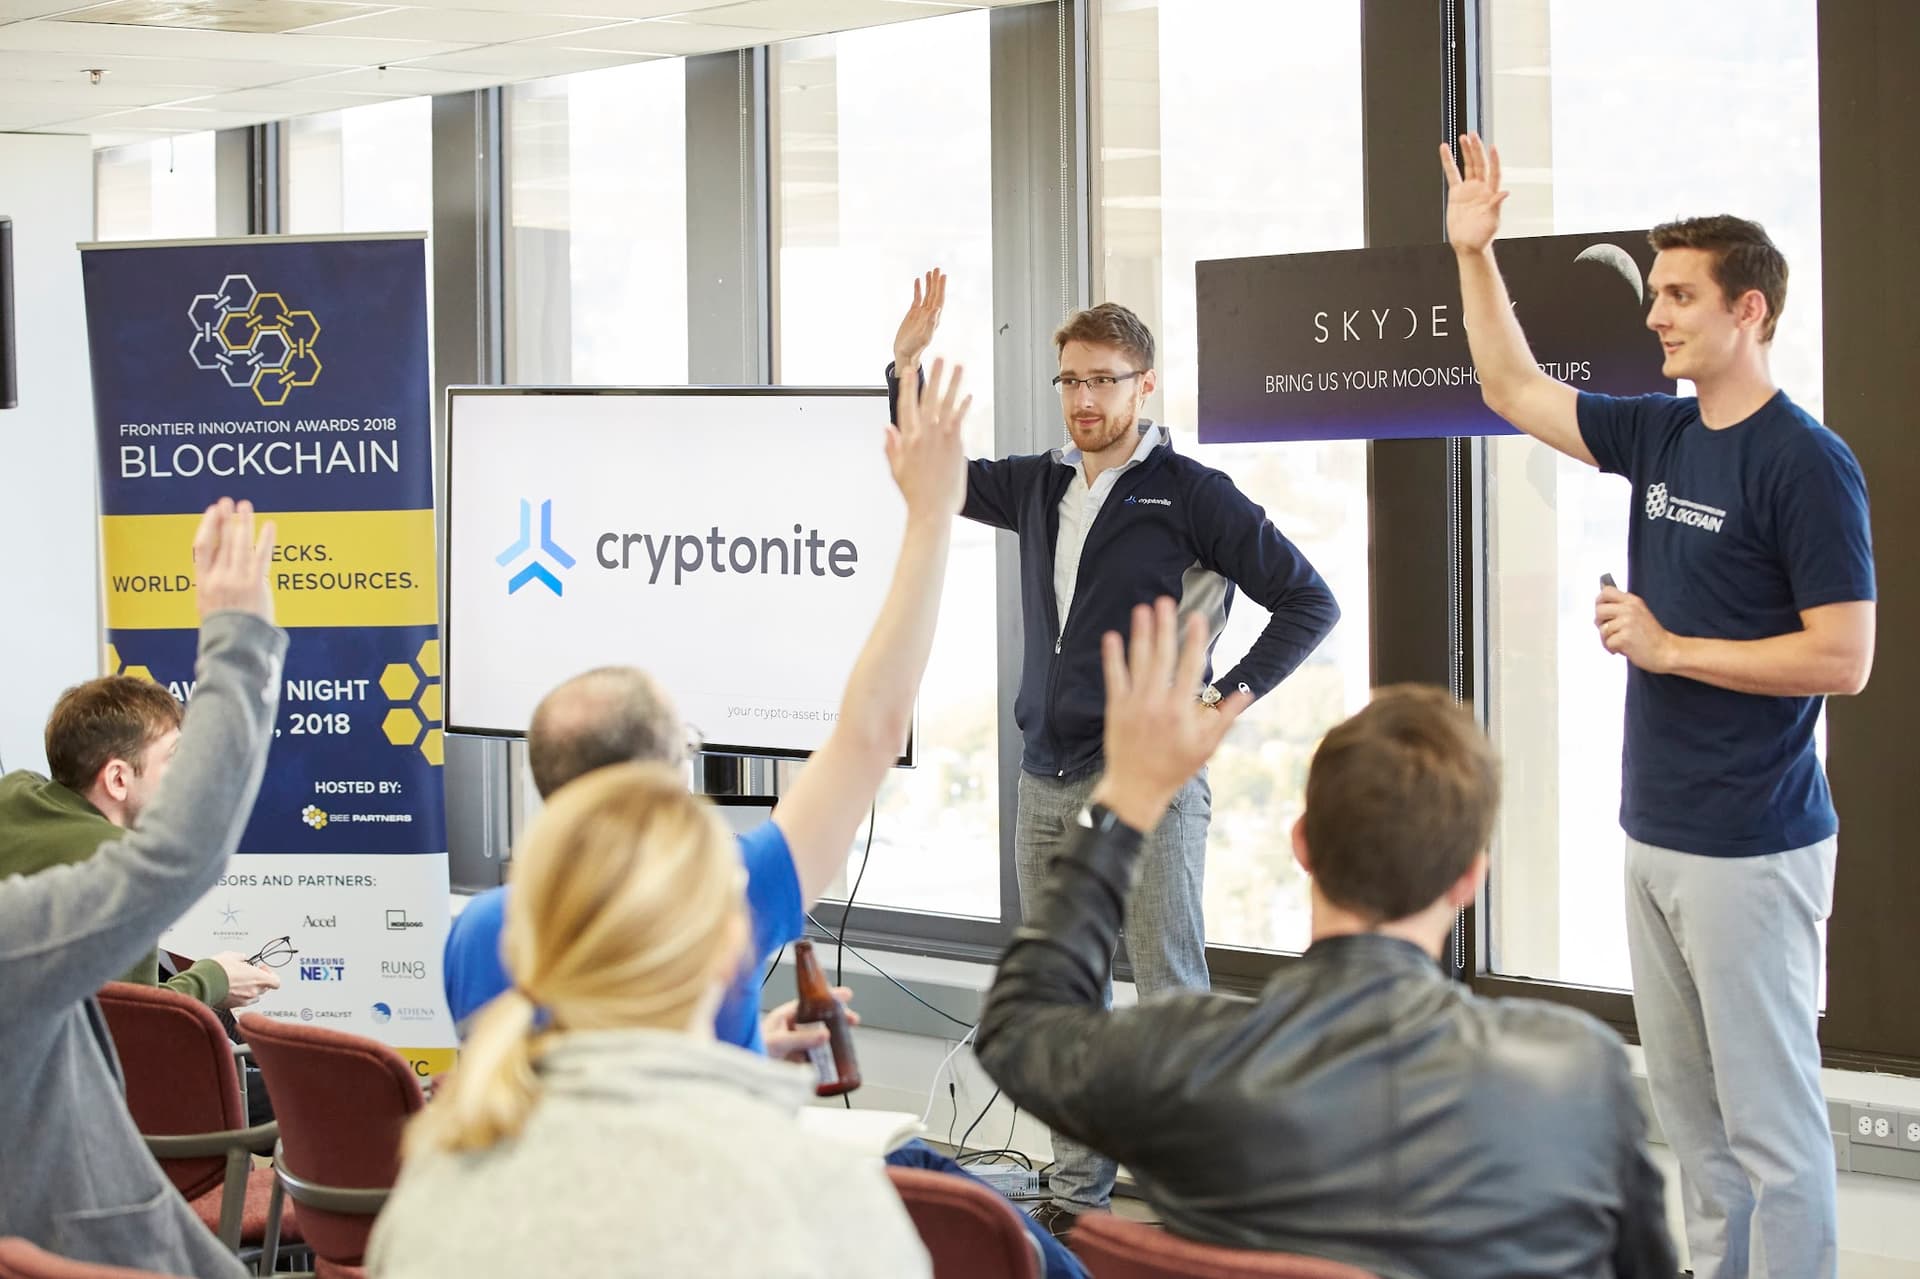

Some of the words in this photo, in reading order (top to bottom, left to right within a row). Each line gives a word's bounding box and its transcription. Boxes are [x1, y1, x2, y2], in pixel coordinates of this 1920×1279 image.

[1265, 374, 1313, 393] BRING
[1318, 372, 1338, 391] US
[1342, 369, 1388, 390] YOUR
[120, 423, 194, 436] FRONTIER
[199, 420, 290, 434] INNOVATION
[295, 419, 359, 432] AWARDS
[364, 418, 396, 431] 2018
[120, 440, 399, 478] BLOCKCHAIN
[271, 545, 333, 562] ECKS.
[596, 523, 858, 585] cryptonite
[278, 573, 419, 590] RESOURCES.
[287, 680, 369, 701] NIGHT
[727, 706, 751, 718] your
[754, 707, 820, 721] crypto-asset
[290, 713, 351, 735] 2018
[315, 781, 375, 794] HOSTED
[379, 781, 402, 794] BY:
[329, 814, 350, 822] BEE
[352, 814, 412, 822] PARTNERS
[262, 875, 293, 886] AND
[298, 875, 376, 887] PARTNERS:
[302, 915, 336, 928] Accel
[301, 967, 344, 981] NEXT
[381, 961, 426, 980] RUN8
[263, 1010, 297, 1018] GENERAL
[397, 1008, 435, 1017] ATHENA
